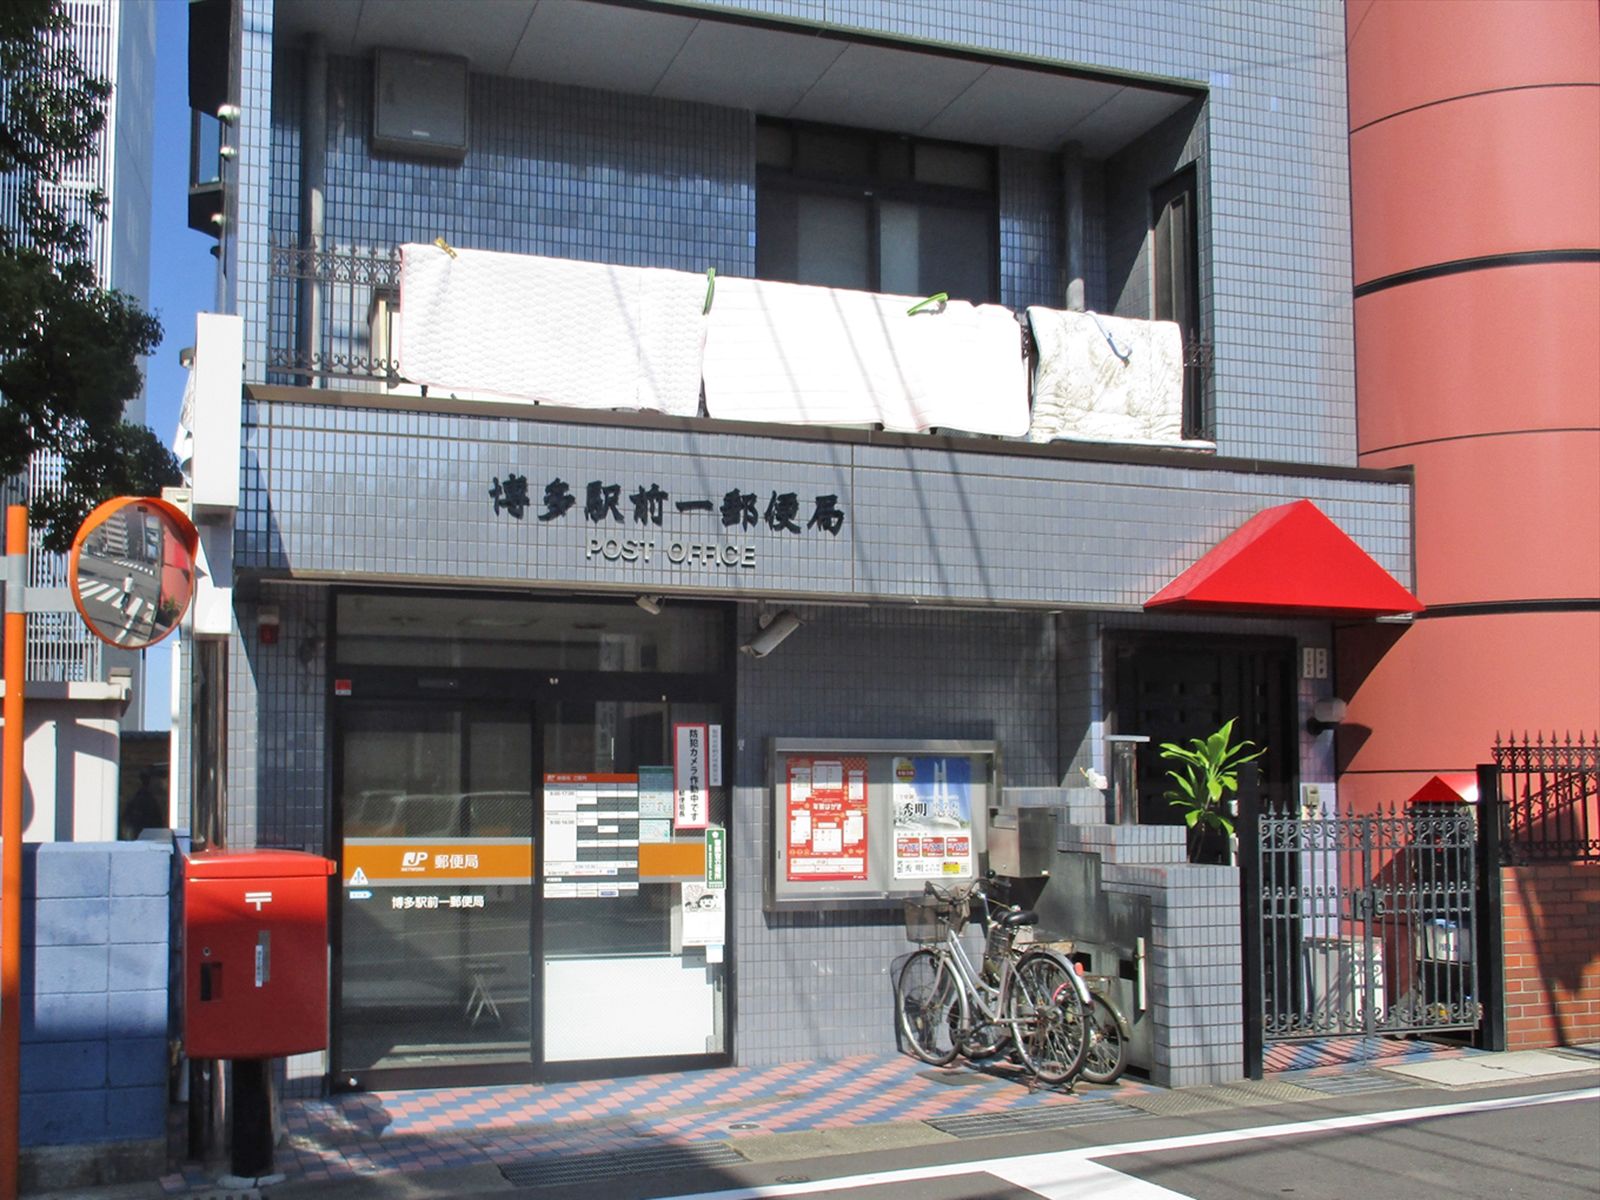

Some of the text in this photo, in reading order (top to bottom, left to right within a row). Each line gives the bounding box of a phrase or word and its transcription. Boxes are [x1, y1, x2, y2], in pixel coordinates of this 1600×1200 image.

[488, 472, 845, 537] 博多駅前一郵便局
[586, 537, 757, 567] POST OFFICE
[689, 729, 699, 822] 防犯カメラ作動中です
[401, 851, 429, 867] JP
[434, 854, 479, 869] 郵便局
[391, 895, 485, 909] 博多駅前一郵便局
